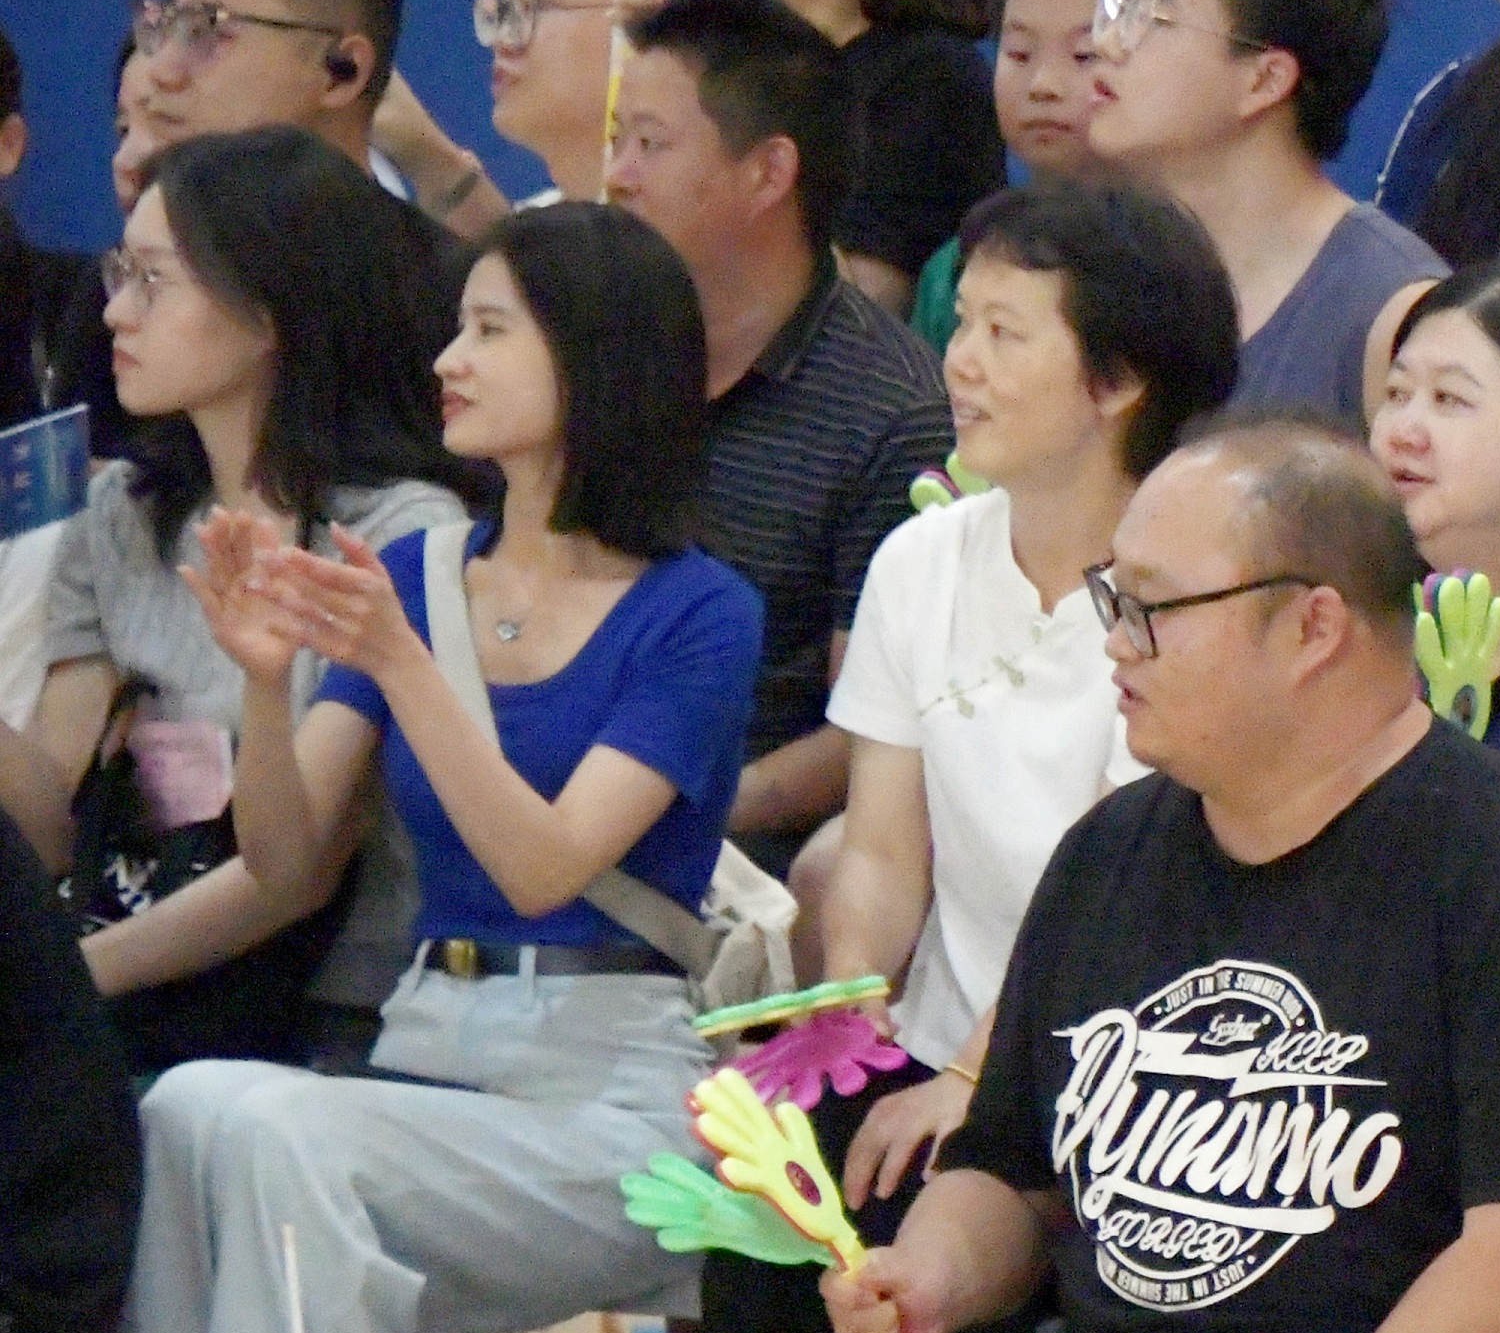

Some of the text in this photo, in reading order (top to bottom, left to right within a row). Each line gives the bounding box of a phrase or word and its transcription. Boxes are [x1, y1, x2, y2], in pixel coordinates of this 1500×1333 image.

[1164, 979, 1195, 1013] JUST
[1199, 975, 1214, 996] IN
[1213, 1259, 1246, 1291] JUST
[1163, 1282, 1189, 1302] THE
[1192, 1279, 1210, 1298] IN
